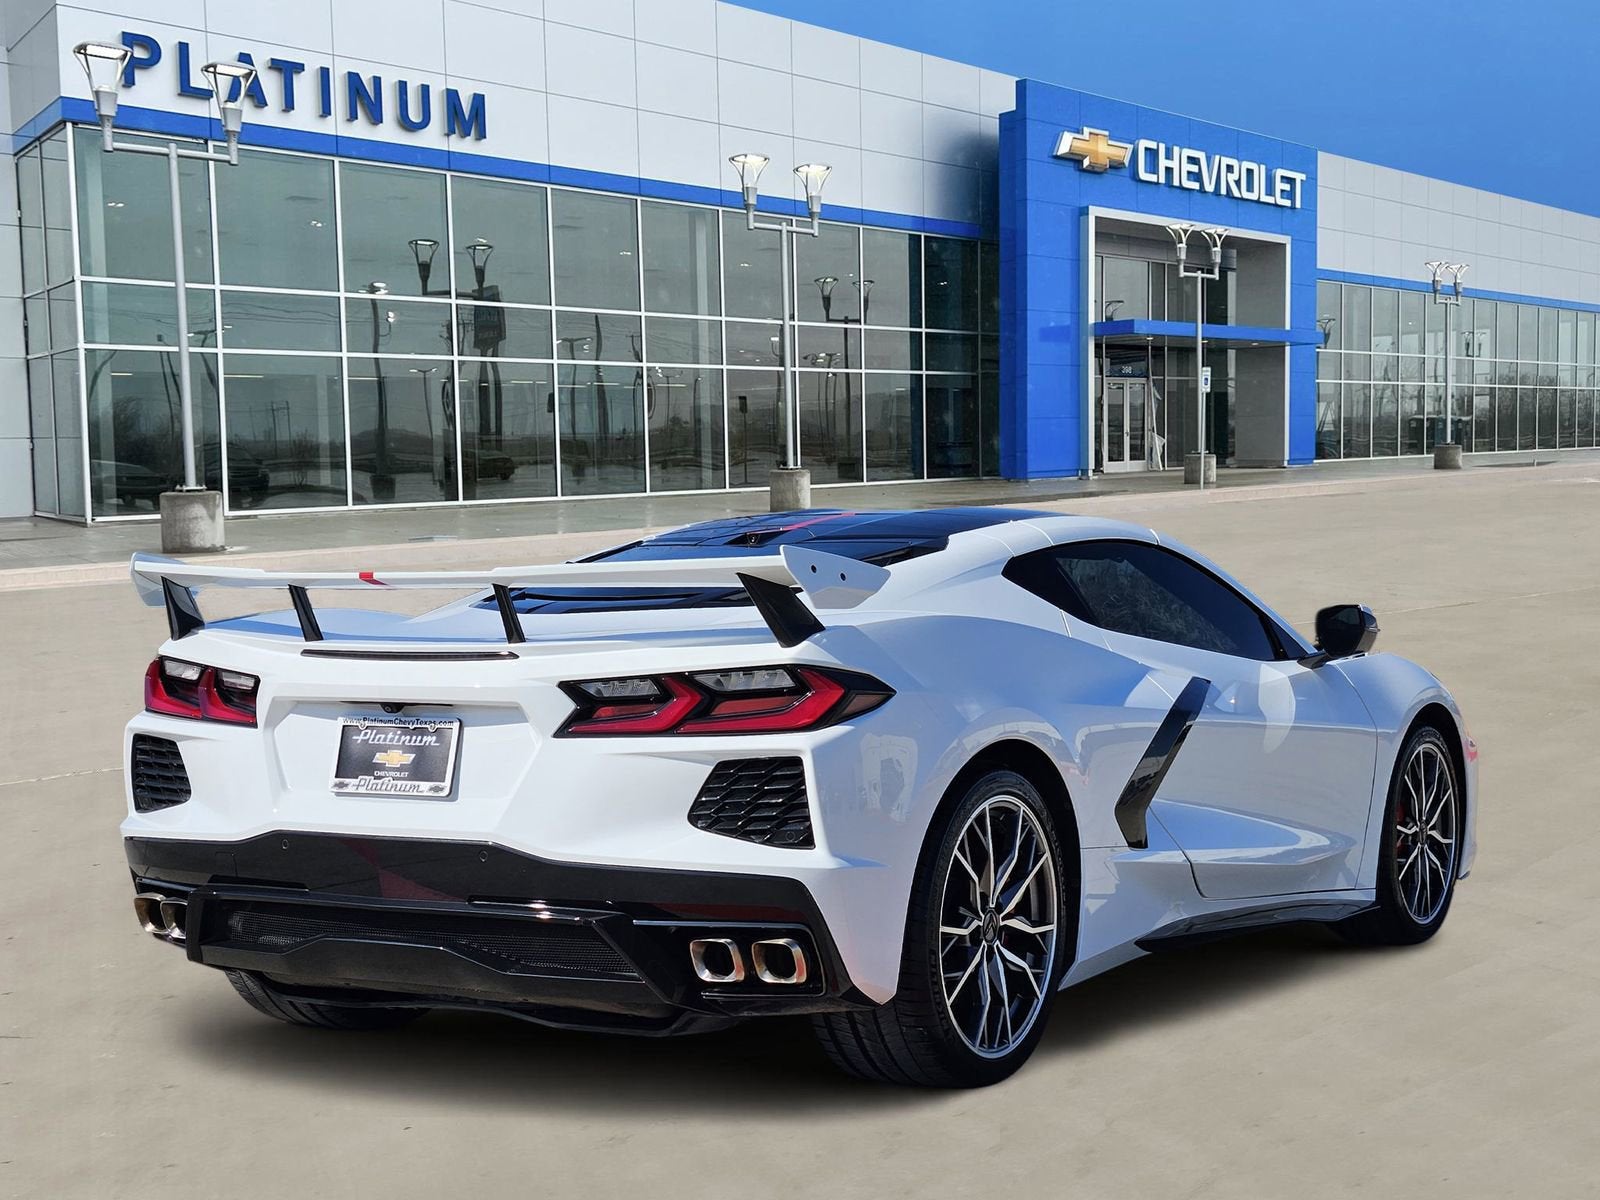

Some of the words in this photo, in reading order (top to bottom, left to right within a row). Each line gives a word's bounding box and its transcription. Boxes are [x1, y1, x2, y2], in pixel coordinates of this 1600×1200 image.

[121, 31, 487, 140] PLATINUM
[1136, 139, 1306, 209] CHEVROLET
[343, 717, 454, 727] www.PlatinumChevyTexas.com
[352, 730, 440, 746] Platinum
[352, 777, 424, 793] Platinum
